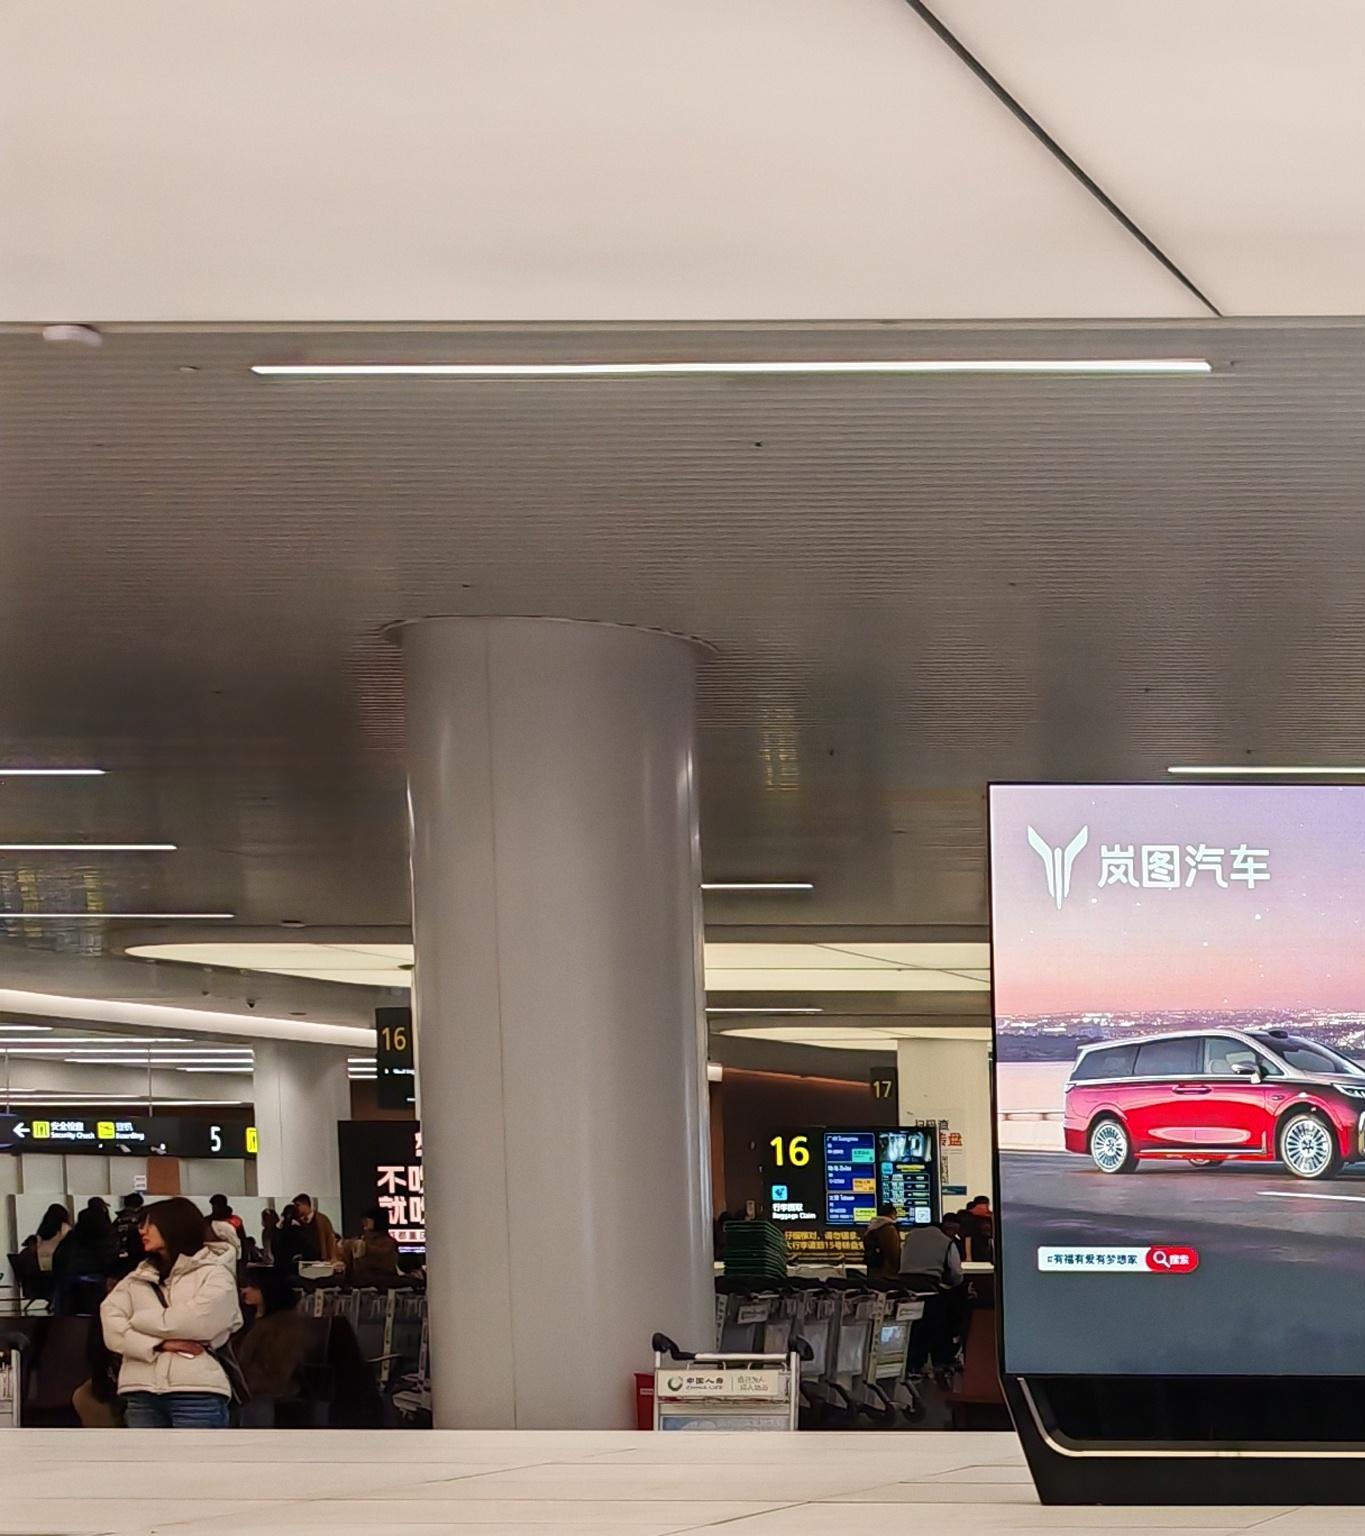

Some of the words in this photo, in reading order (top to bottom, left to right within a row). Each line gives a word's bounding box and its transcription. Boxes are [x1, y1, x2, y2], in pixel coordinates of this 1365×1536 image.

[1096, 843, 1271, 891] 岚图汽车
[381, 1026, 407, 1051] 16
[873, 1080, 892, 1098] 17
[210, 1126, 222, 1152] 5
[769, 1135, 810, 1167] 16
